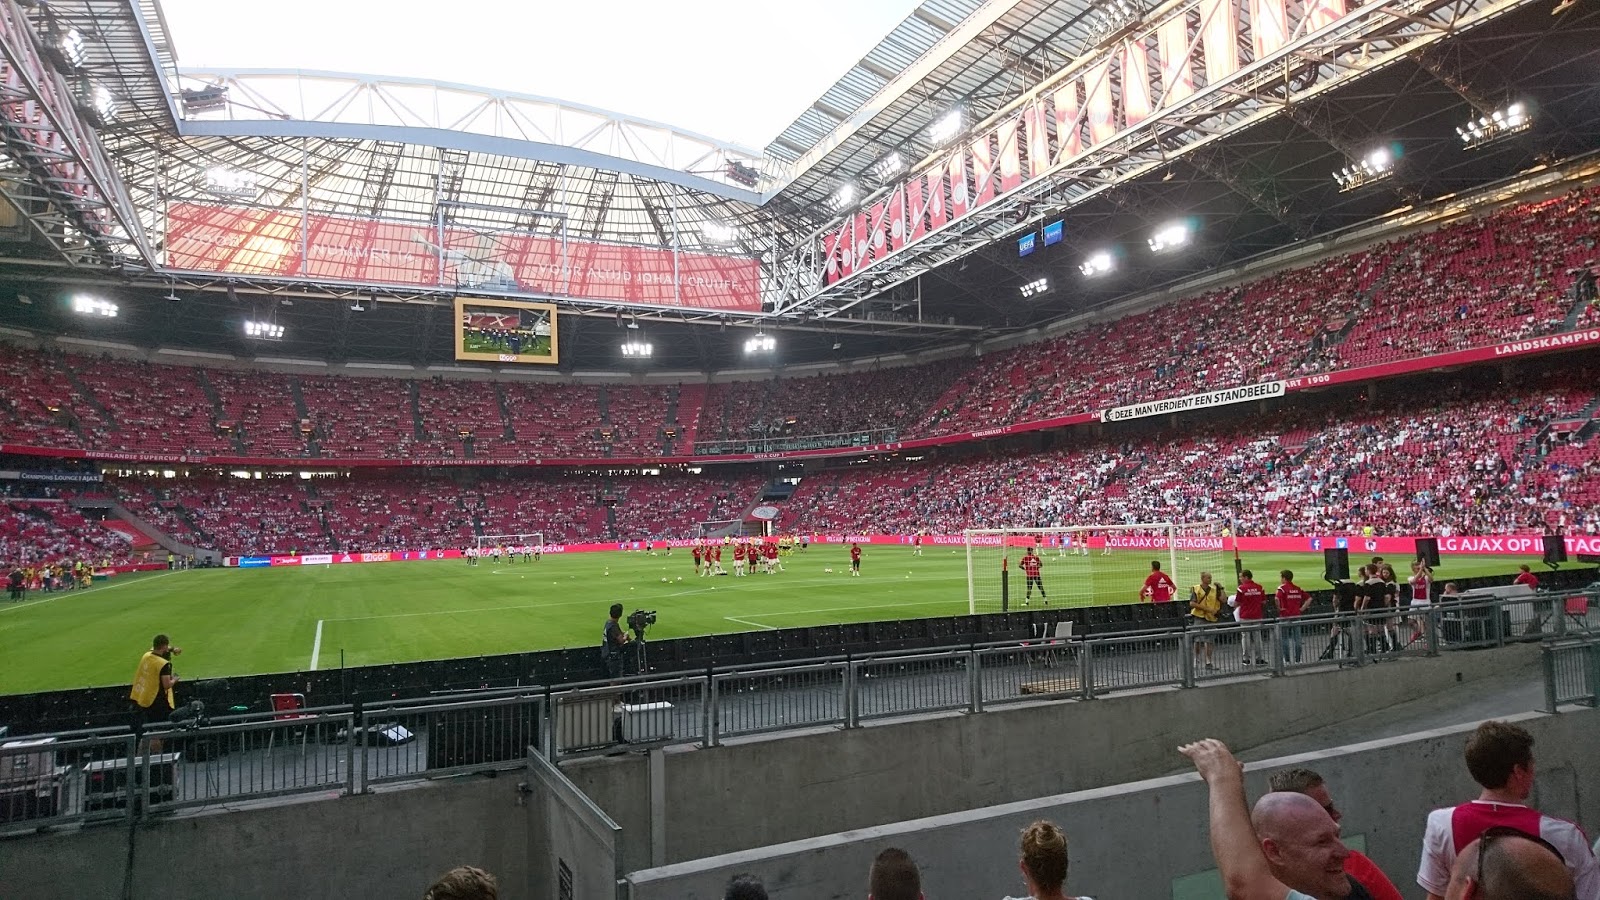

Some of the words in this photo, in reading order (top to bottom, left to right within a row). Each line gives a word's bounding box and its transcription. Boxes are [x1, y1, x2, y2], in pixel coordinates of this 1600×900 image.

[313, 242, 389, 258] NUMMER
[538, 263, 582, 276] VOOR
[586, 267, 631, 281] ALTIJD
[637, 272, 683, 285] JOHAN
[1495, 331, 1600, 355] LANDSKAMPIO
[1308, 375, 1330, 384] 1900
[1114, 409, 1133, 420] DEZE
[1135, 405, 1153, 416] MAN
[1154, 399, 1193, 413] VERDIENT
[1195, 395, 1212, 406] EEN
[1214, 383, 1281, 403] STANDBEELD
[85, 451, 138, 460] NEDERLANDSE
[139, 454, 179, 462] SUPERCUP
[970, 537, 1002, 545] NSTAGRAM
[1110, 538, 1128, 547] OLG
[1129, 538, 1152, 547] AJAX
[1153, 538, 1166, 547] OP
[1438, 539, 1457, 551] LG
[1461, 539, 1503, 551] AJAX
[1507, 539, 1531, 551] OP
